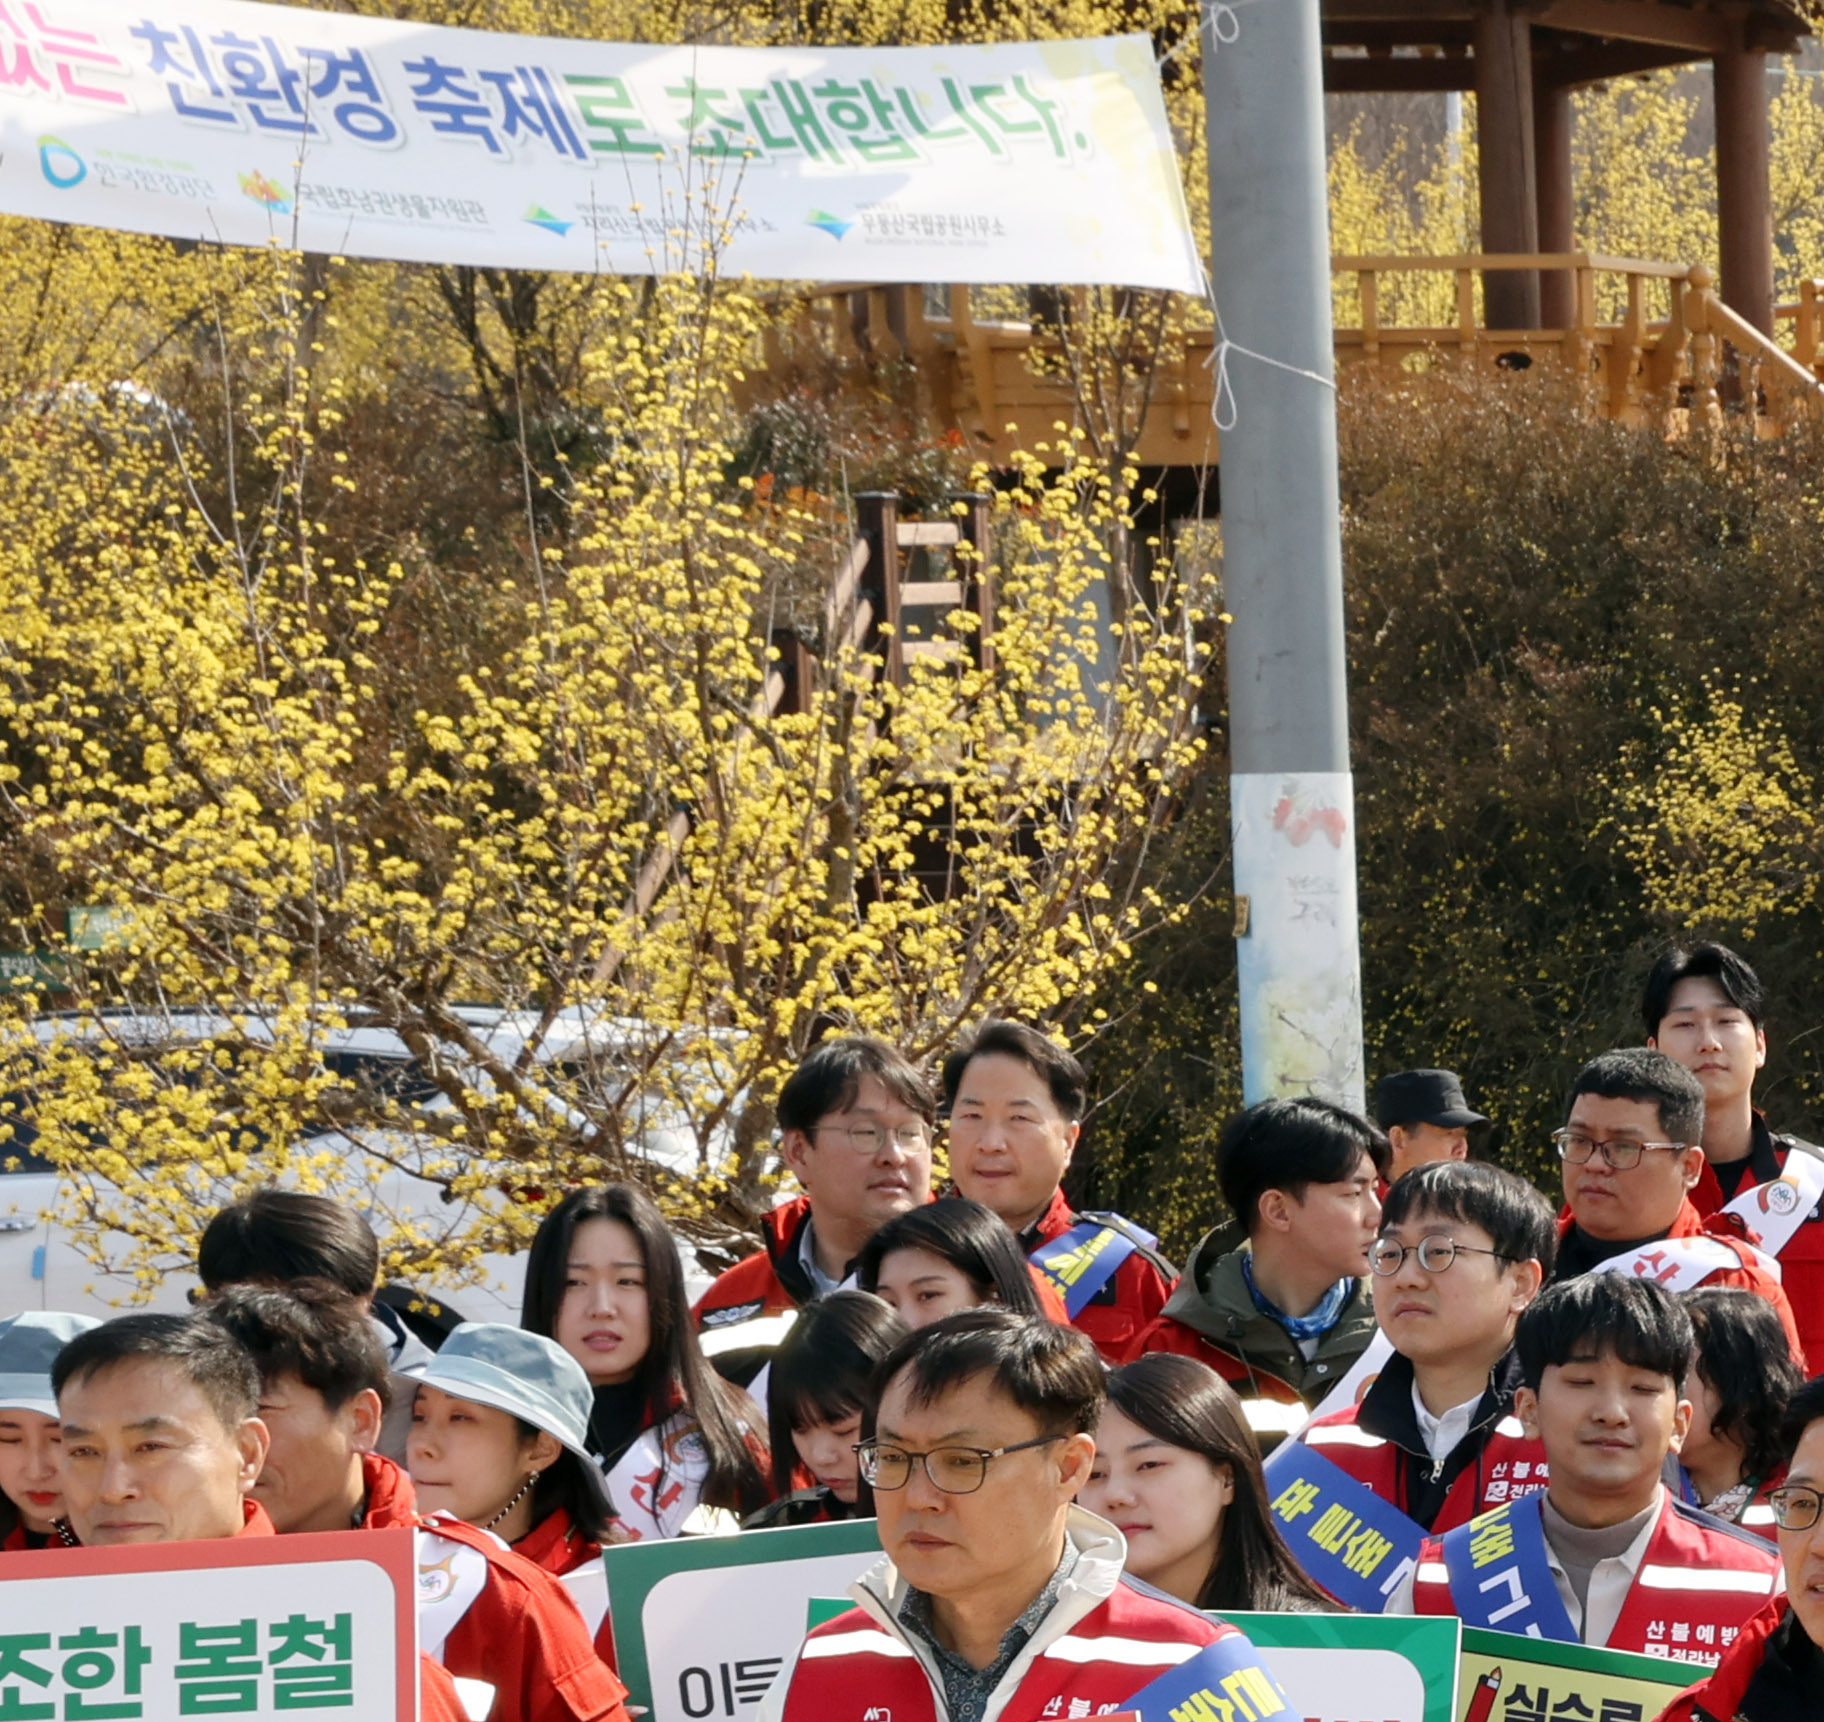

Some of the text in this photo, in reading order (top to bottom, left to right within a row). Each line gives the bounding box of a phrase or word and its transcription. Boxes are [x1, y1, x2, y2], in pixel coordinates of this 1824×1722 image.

[129, 18, 402, 143] 친환경
[402, 55, 662, 162] 축제로
[663, 74, 1089, 166] 초대합니다.
[174, 1612, 355, 1716] 봄철
